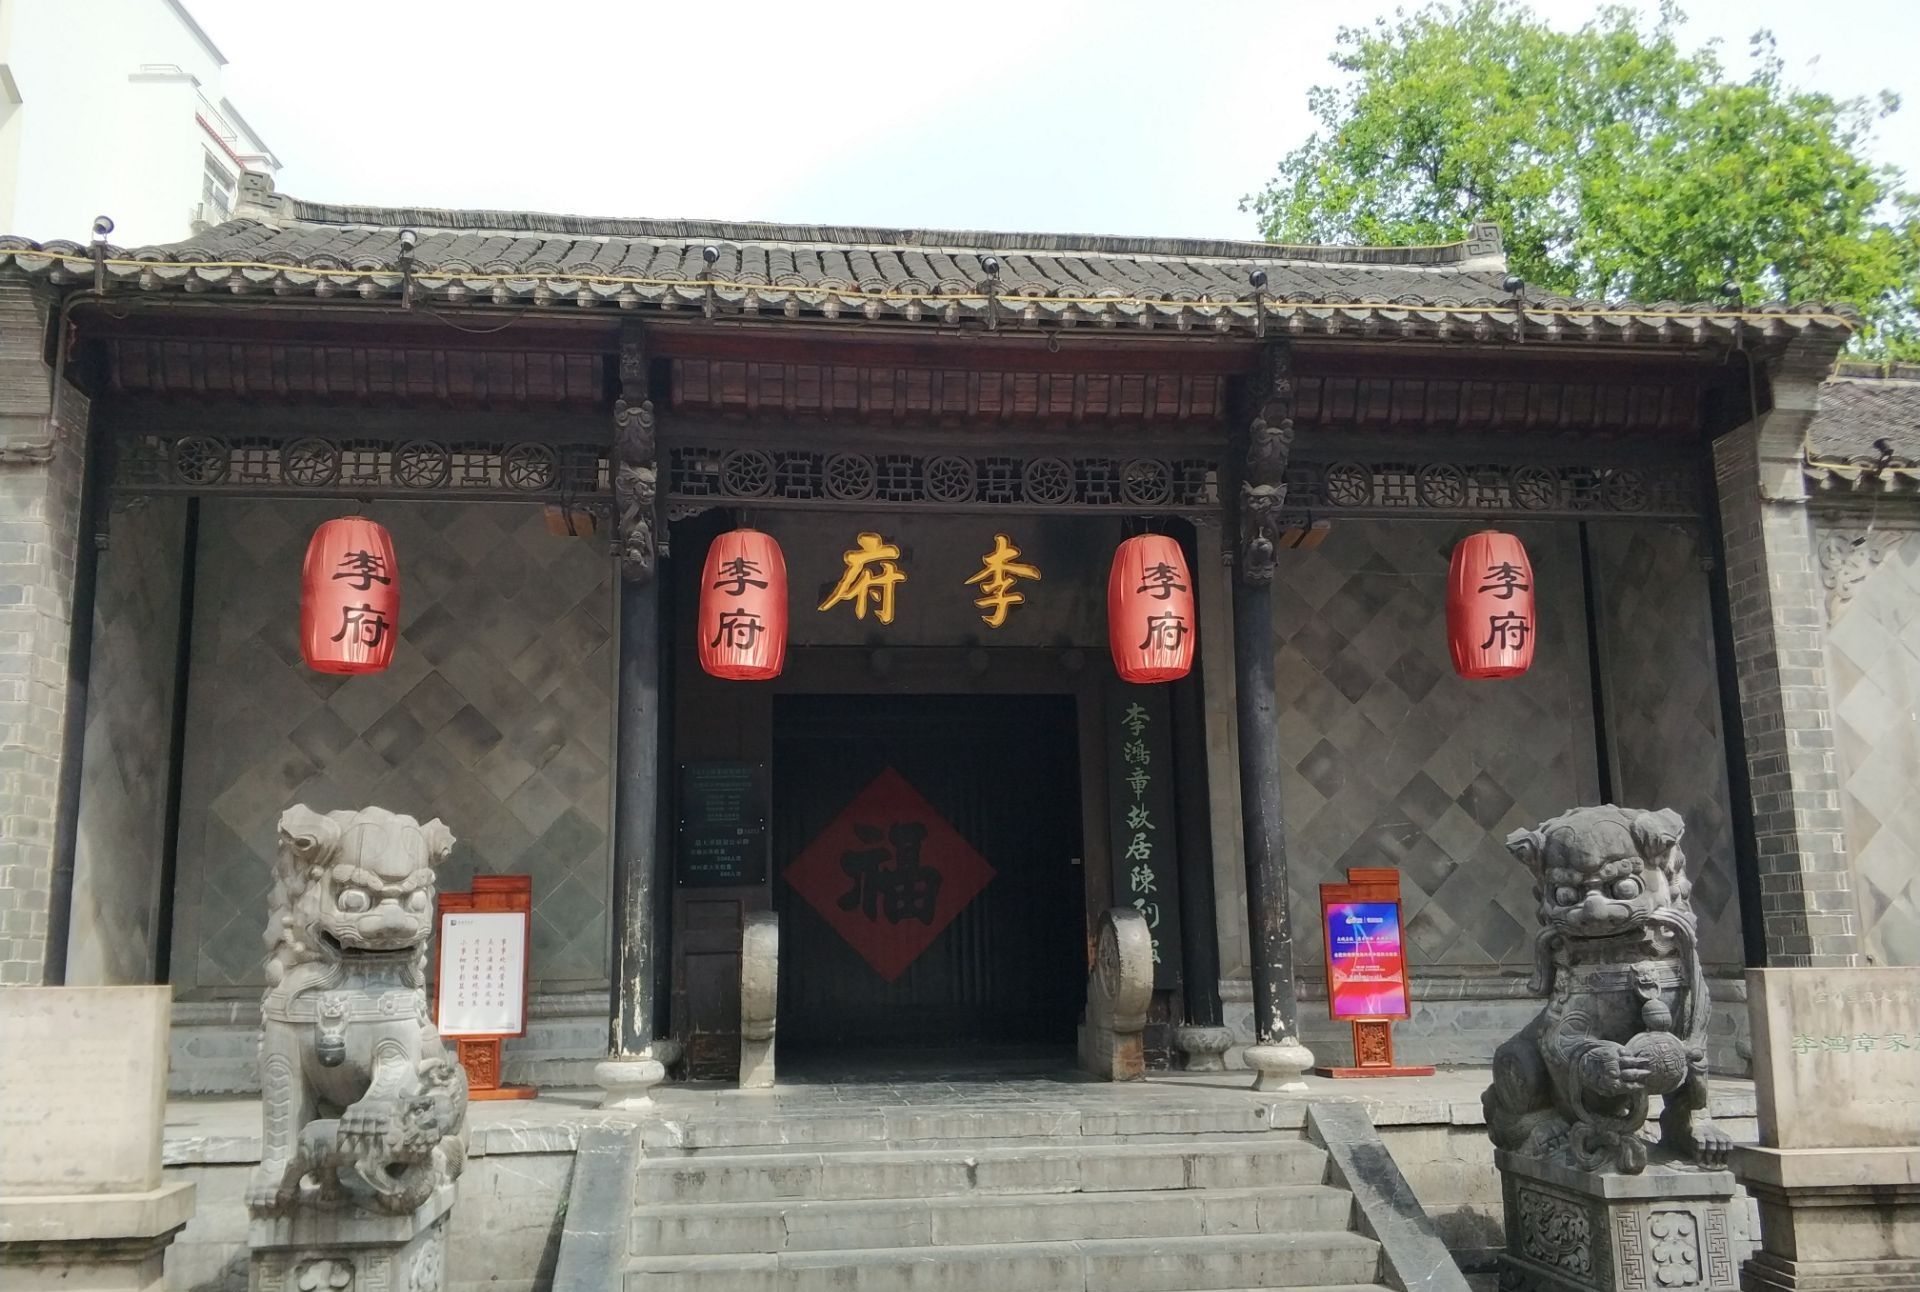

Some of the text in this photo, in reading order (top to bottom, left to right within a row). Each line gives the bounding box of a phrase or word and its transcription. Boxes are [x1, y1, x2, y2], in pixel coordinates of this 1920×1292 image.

[331, 549, 391, 648] 李府
[710, 556, 769, 651] 李府
[1136, 561, 1189, 652] 李府
[1478, 561, 1530, 652] 李府
[837, 822, 943, 926] 福
